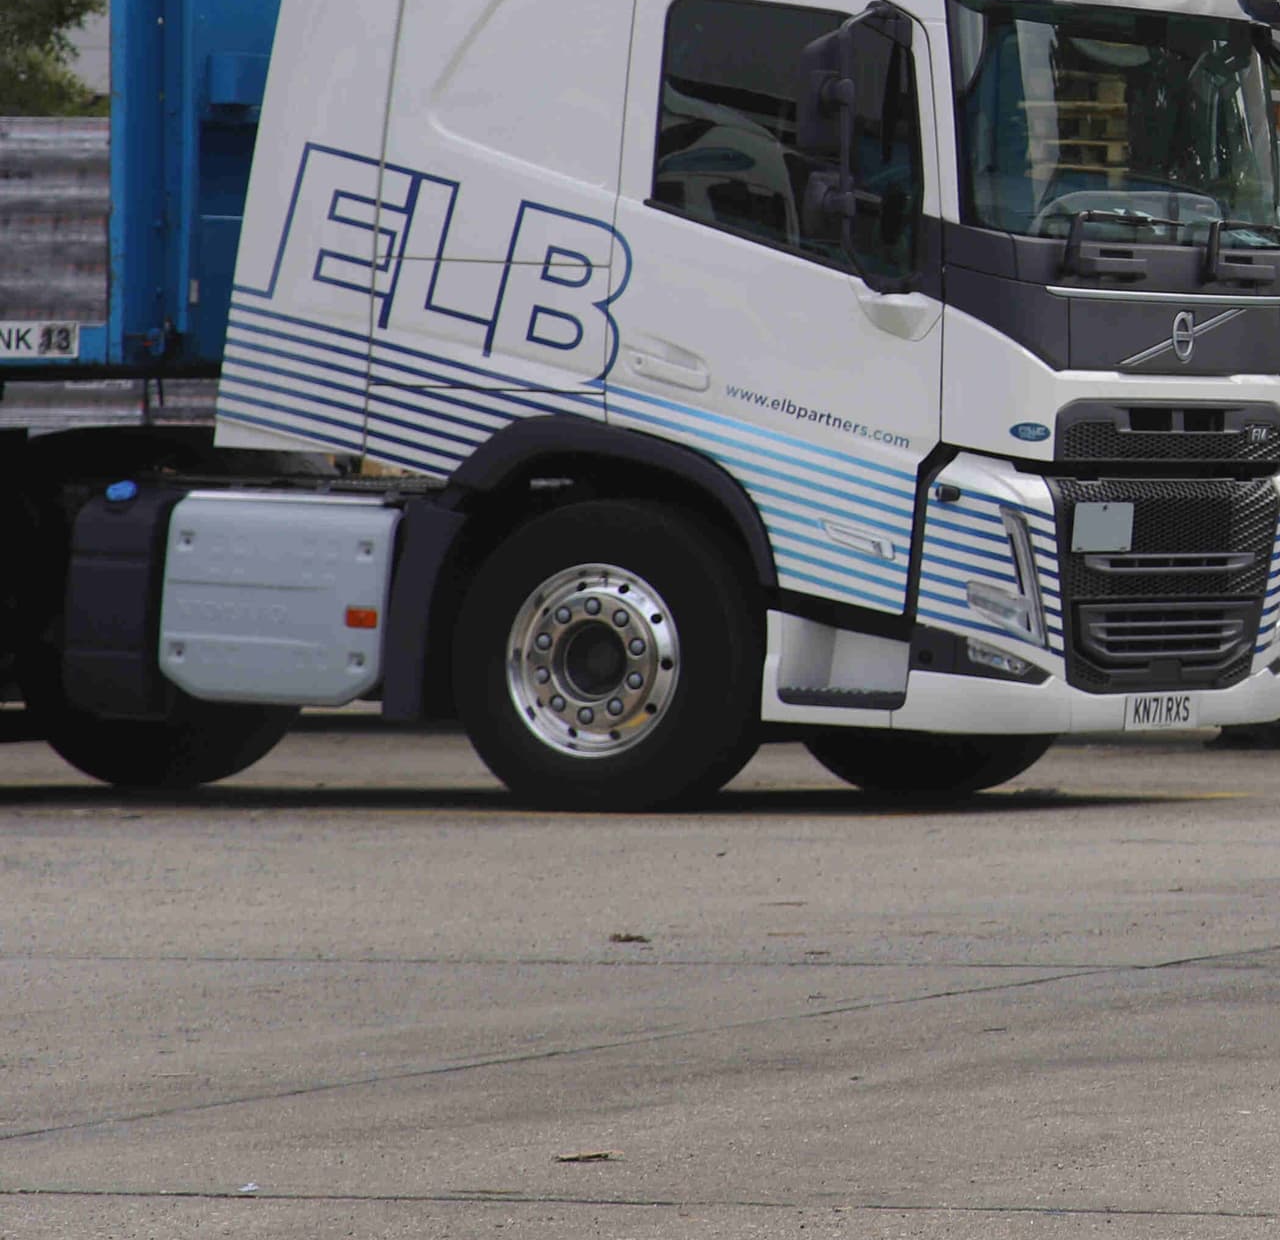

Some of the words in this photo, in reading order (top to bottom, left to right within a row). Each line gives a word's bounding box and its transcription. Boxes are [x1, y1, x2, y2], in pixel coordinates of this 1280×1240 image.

[264, 142, 632, 388] ELB
[726, 384, 909, 448] www.elbpartners.com
[1133, 697, 1163, 723] KN71
[1165, 695, 1190, 722] RXS
